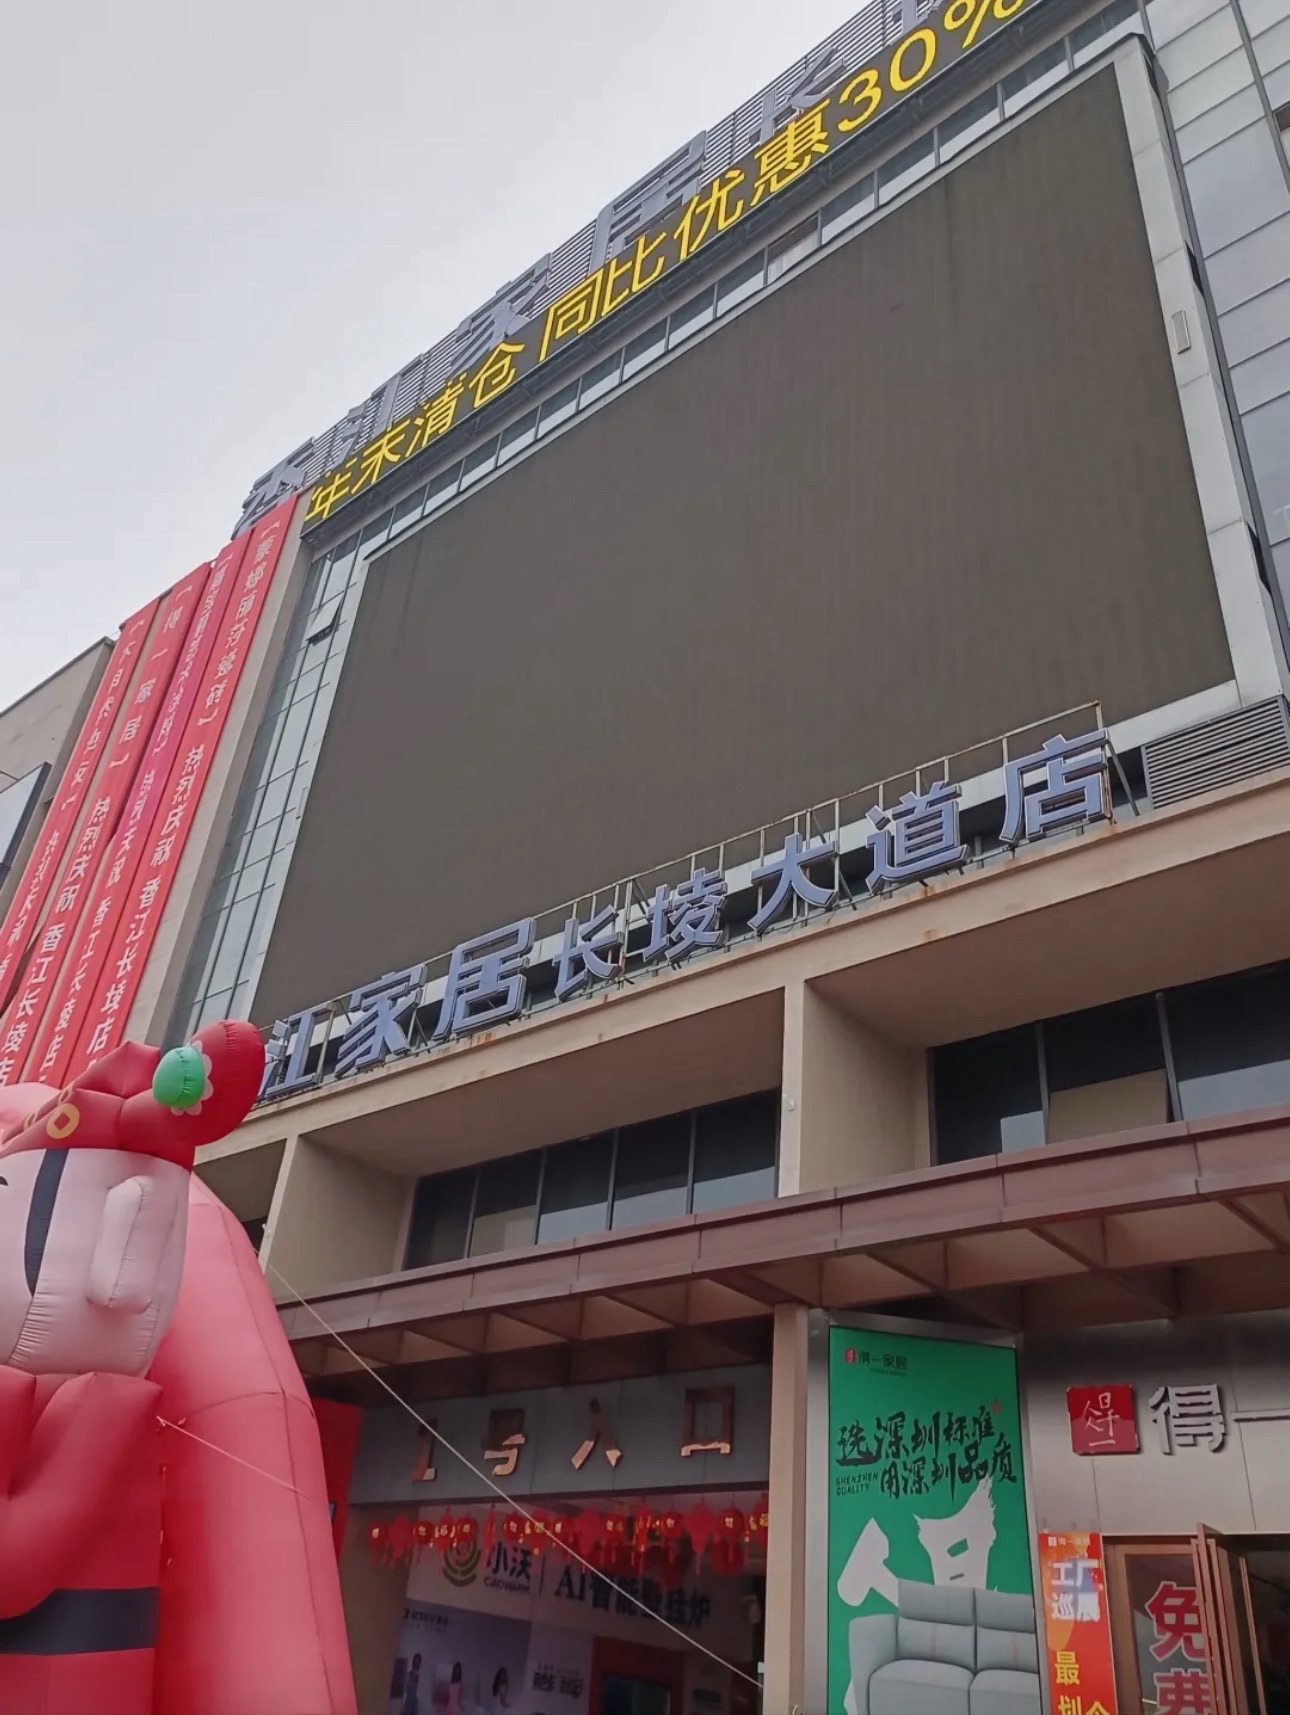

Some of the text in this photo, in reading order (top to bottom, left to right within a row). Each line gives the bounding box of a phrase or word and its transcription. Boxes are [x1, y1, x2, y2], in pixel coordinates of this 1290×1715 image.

[304, 0, 1025, 522] 年末清仓 同比优惠30%
[150, 743, 205, 869] 热烈庆祝
[54, 798, 112, 914] 热烈庆祝
[411, 1385, 735, 1482] 1号入口
[836, 1405, 996, 1467] 选深圳标准
[835, 1472, 879, 1487] SHENZHEN
[836, 1482, 871, 1496] QUALITY
[880, 1432, 1018, 1503] 用深圳品质
[485, 1541, 532, 1581] 小沃
[1051, 1559, 1099, 1588] 工厂
